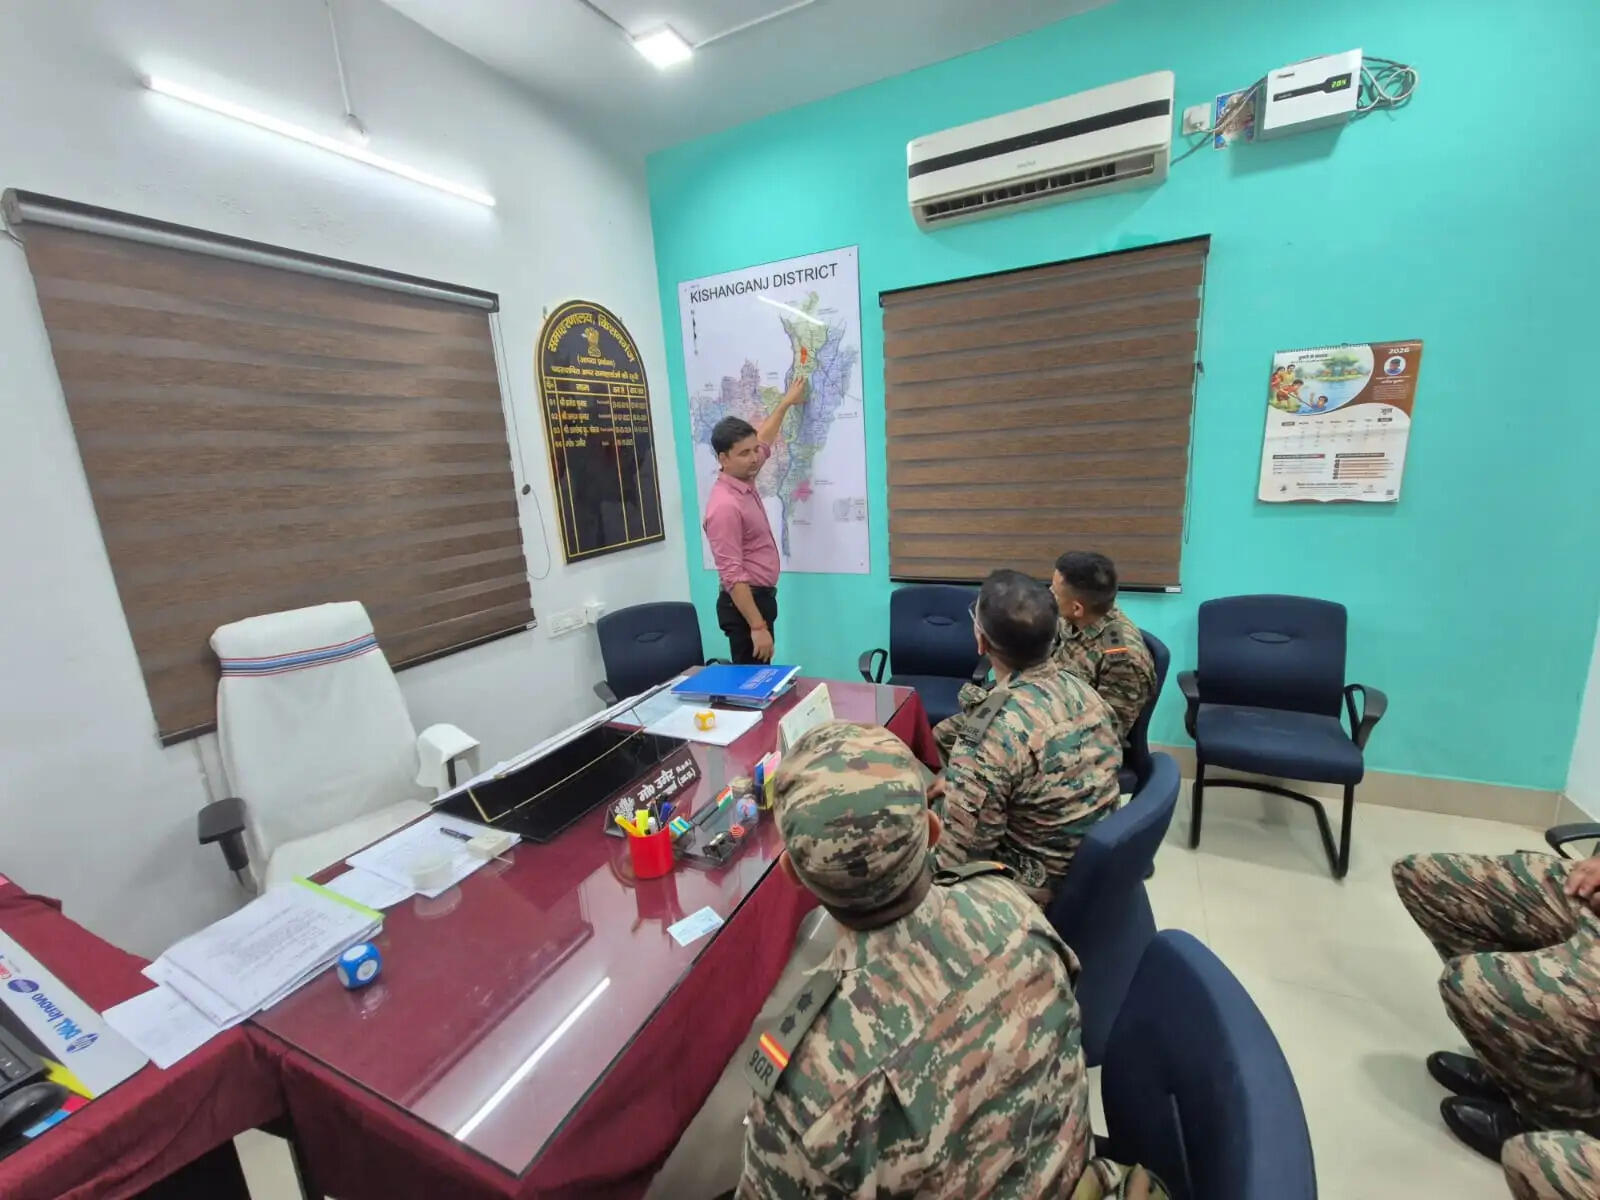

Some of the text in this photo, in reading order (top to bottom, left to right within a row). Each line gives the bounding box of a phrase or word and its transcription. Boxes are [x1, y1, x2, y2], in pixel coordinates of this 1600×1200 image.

[690, 262, 838, 304] KISHANGANJ DISTRICT
[31, 992, 65, 1022] lenovo
